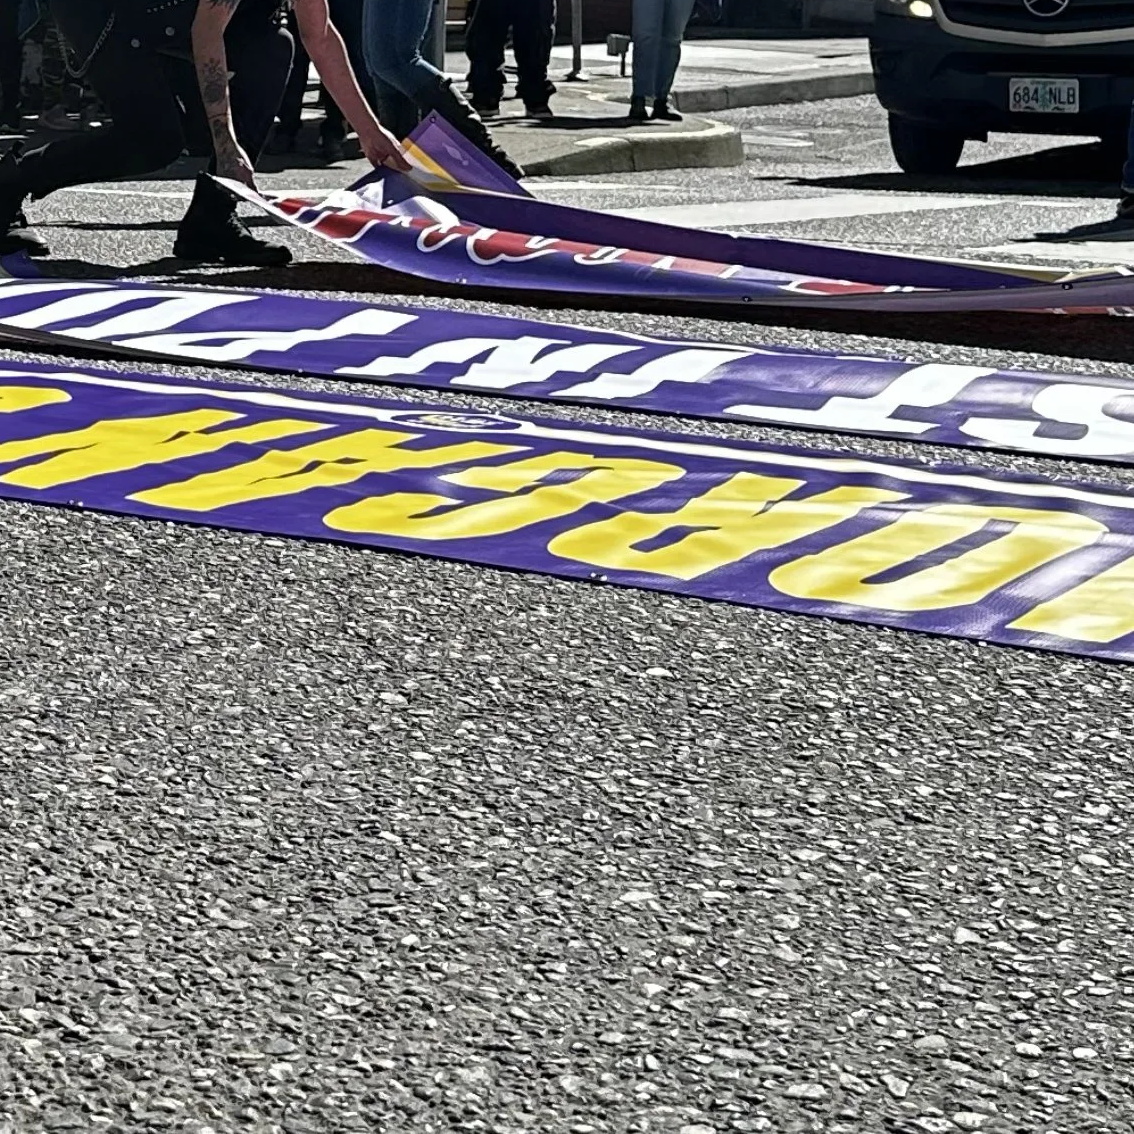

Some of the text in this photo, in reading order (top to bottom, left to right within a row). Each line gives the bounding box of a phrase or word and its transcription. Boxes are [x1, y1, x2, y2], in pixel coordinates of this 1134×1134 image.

[1013, 86, 1076, 106] 684 NLB
[333, 336, 759, 400] IN
